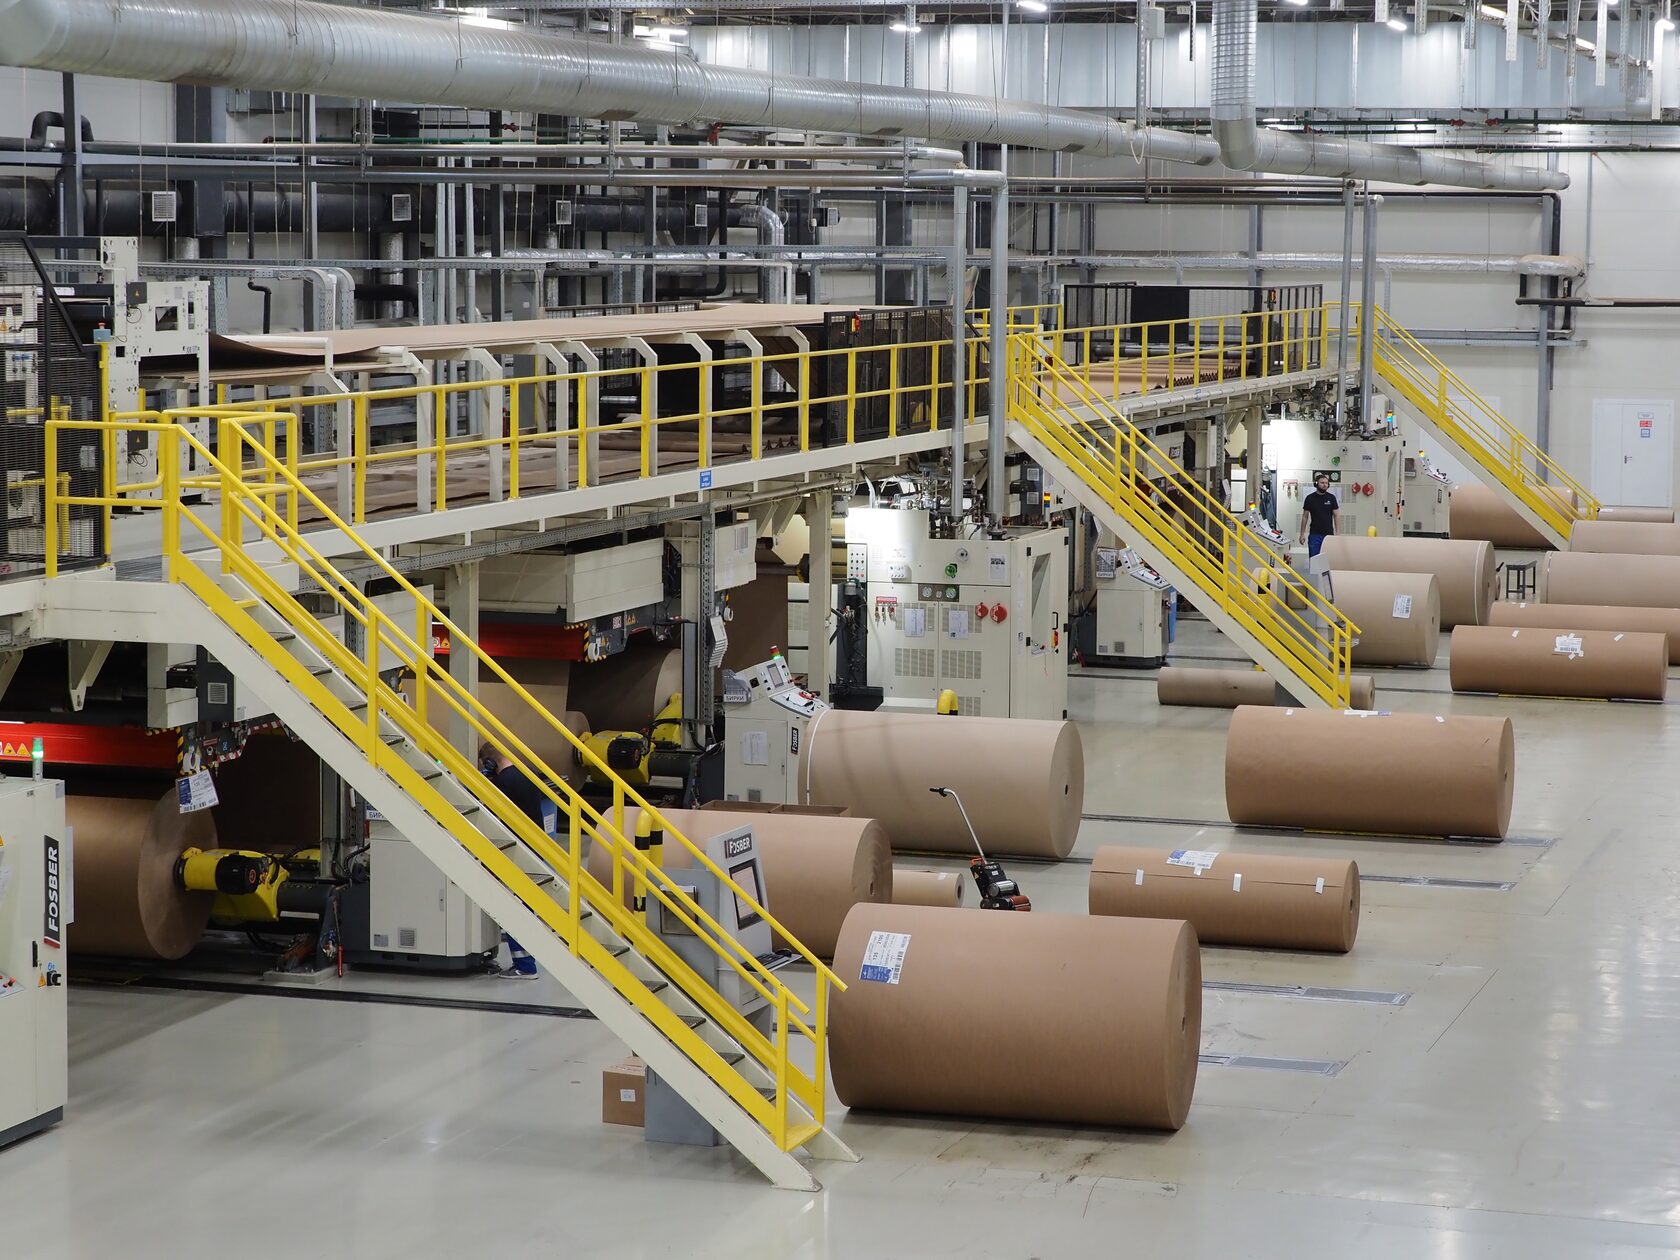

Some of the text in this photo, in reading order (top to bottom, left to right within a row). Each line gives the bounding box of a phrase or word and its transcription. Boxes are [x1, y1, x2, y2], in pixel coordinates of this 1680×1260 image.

[791, 729, 799, 752] FOSBER
[369, 811, 384, 819] БИР
[729, 836, 751, 854] FOSBER
[48, 846, 59, 933] FOSBER
